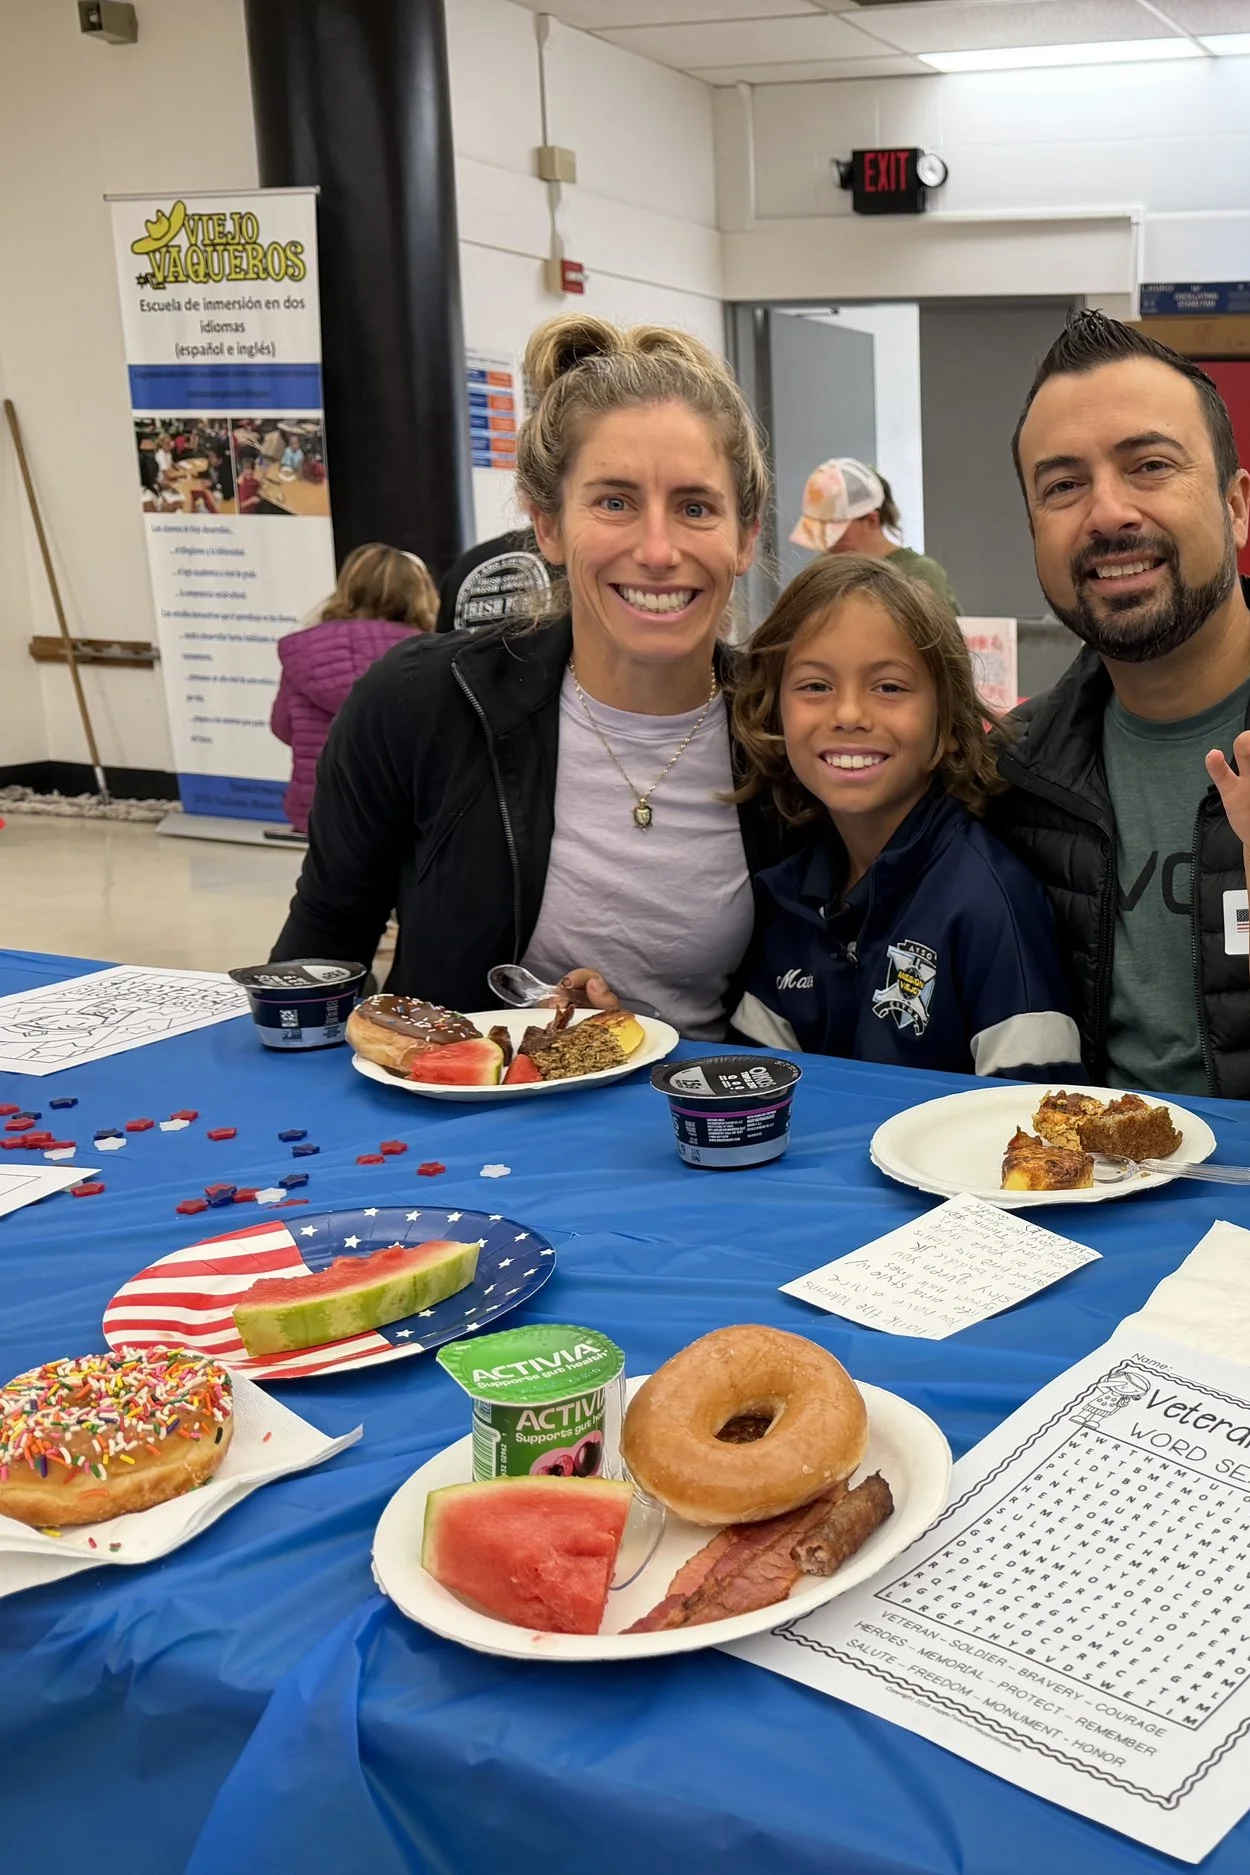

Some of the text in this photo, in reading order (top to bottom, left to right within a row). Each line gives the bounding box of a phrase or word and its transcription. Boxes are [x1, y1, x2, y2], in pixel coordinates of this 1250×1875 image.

[864, 151, 910, 192] EXIT
[183, 212, 259, 245] VIEJO
[146, 241, 307, 284] VAQUEROS
[139, 297, 306, 313] Escuela de inmersión en dos
[200, 321, 246, 334] idiomas
[176, 342, 276, 358] (español e inglés)
[909, 946, 932, 960] AYSO
[892, 1251, 922, 1265] you
[870, 1270, 907, 1289] style
[884, 1262, 912, 1280] lines
[909, 1288, 943, 1304] and
[854, 1302, 882, 1319] the
[892, 1300, 936, 1316] have
[473, 1342, 601, 1383] ACTIVIA
[1132, 1352, 1174, 1372] Name:
[476, 1374, 540, 1390] Supports
[541, 1366, 567, 1380] gut
[516, 1427, 573, 1445] Supports
[1130, 1422, 1208, 1462] WORD
[882, 1610, 1167, 1739] VETERAN SOLDIER BRAVERY COURAGE
[854, 1620, 1158, 1757] HEROES MEMORIAL PROTECT REMEMBER
[846, 1638, 1127, 1768] SALUTE FREEDOM MONUMENT HONOR
